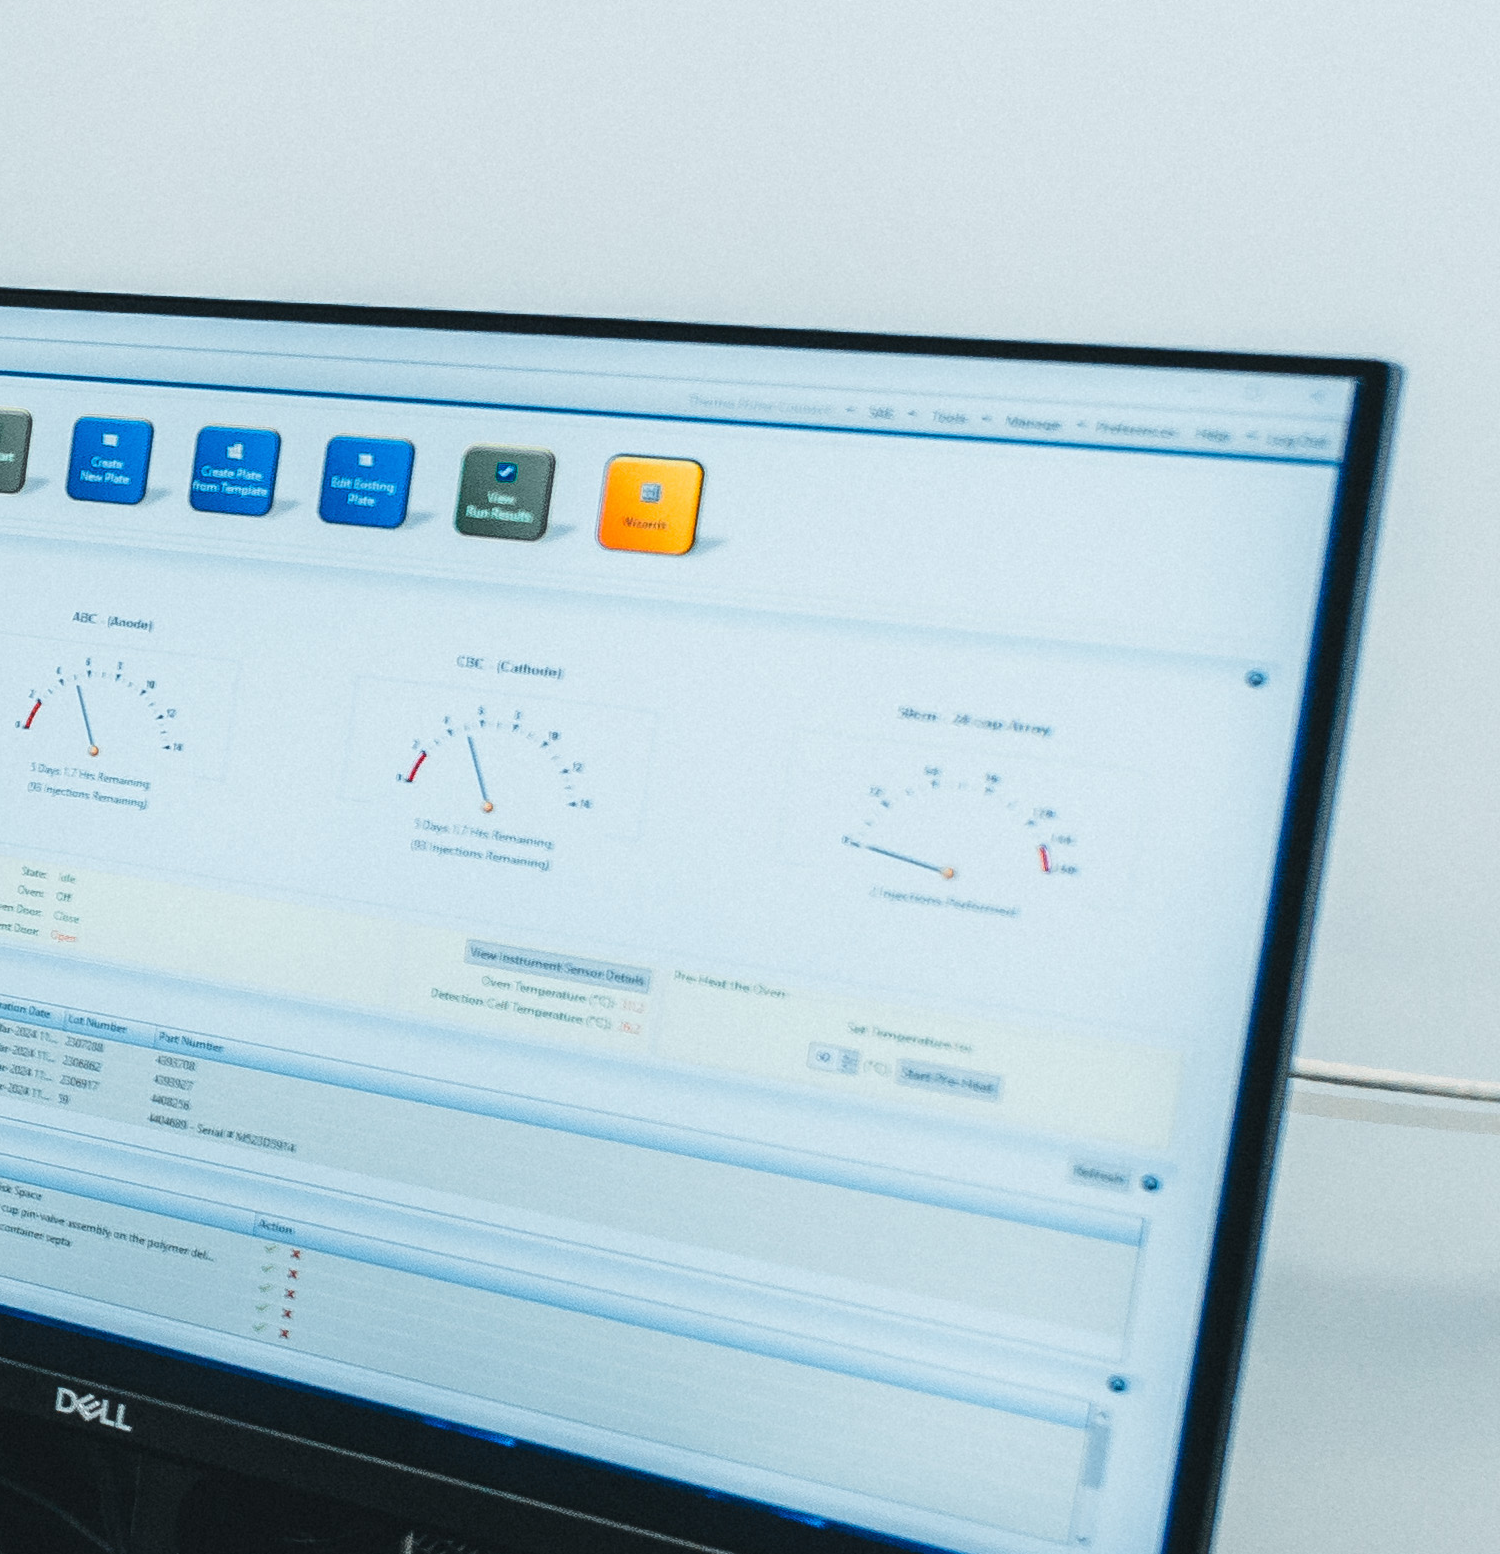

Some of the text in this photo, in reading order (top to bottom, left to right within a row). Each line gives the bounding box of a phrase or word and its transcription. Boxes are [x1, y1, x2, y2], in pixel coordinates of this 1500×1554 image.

[89, 456, 124, 471] Create
[199, 465, 264, 483] Create Plate
[79, 470, 131, 486] New Plate
[329, 475, 354, 490] Edit
[191, 479, 269, 500] from Template
[345, 492, 377, 508] Plate
[72, 610, 154, 633] ABC (Anode)
[469, 945, 498, 962] View
[498, 950, 563, 973] Instrument
[562, 961, 604, 980] Sensor
[513, 980, 586, 1005] Temperature
[510, 1001, 583, 1027] Temperature
[28, 1005, 51, 1019] Date
[67, 1013, 85, 1026] Lot
[86, 1017, 127, 1035] Number
[157, 1031, 179, 1045] Part
[180, 1035, 224, 1054] Number
[13, 1185, 43, 1204] Space
[0, 1204, 19, 1217] cup
[66, 1217, 111, 1240] assembly
[112, 1230, 127, 1242] on
[127, 1232, 145, 1246] the
[145, 1236, 189, 1259] polymer
[258, 1218, 293, 1236] Action
[55, 1386, 133, 1432] DELL
